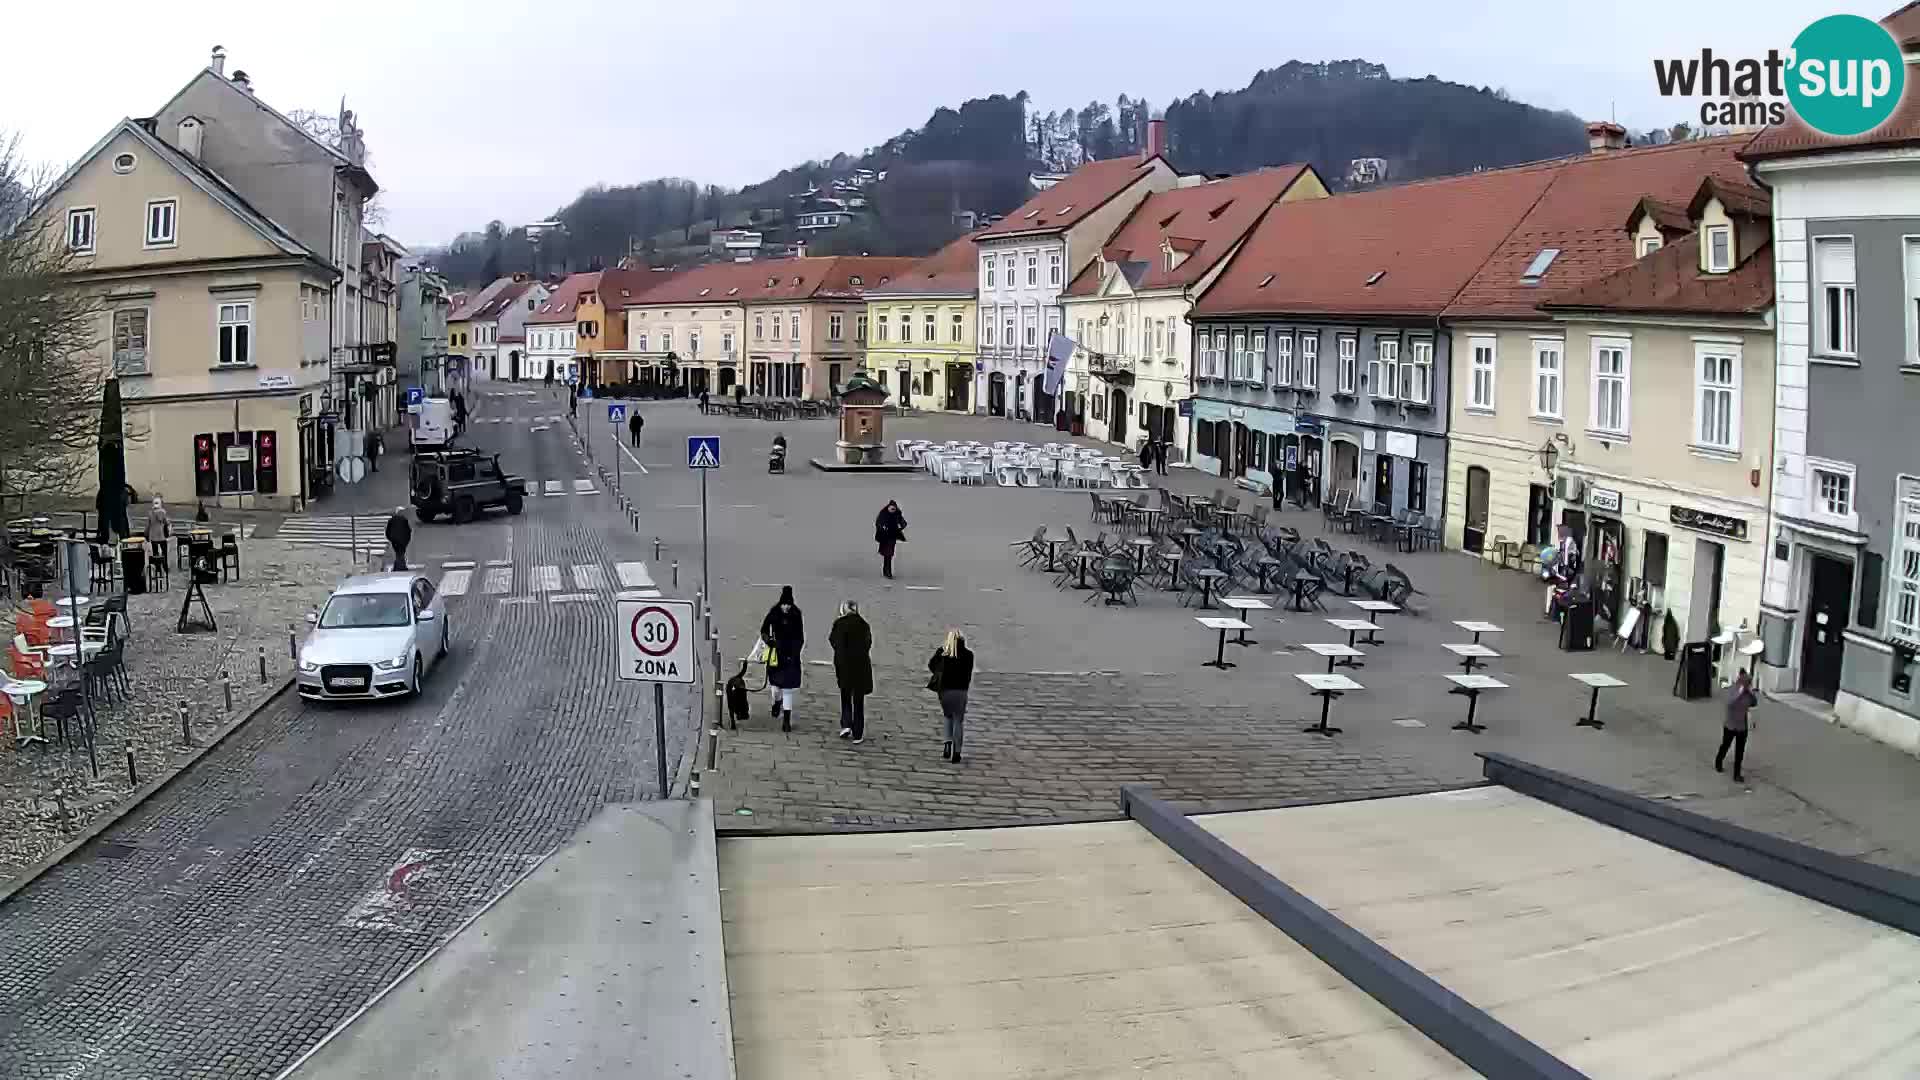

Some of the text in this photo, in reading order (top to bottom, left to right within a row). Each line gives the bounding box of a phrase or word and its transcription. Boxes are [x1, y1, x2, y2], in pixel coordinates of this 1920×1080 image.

[411, 391, 419, 401] P
[644, 622, 667, 643] 30
[634, 659, 679, 676] ZONA
